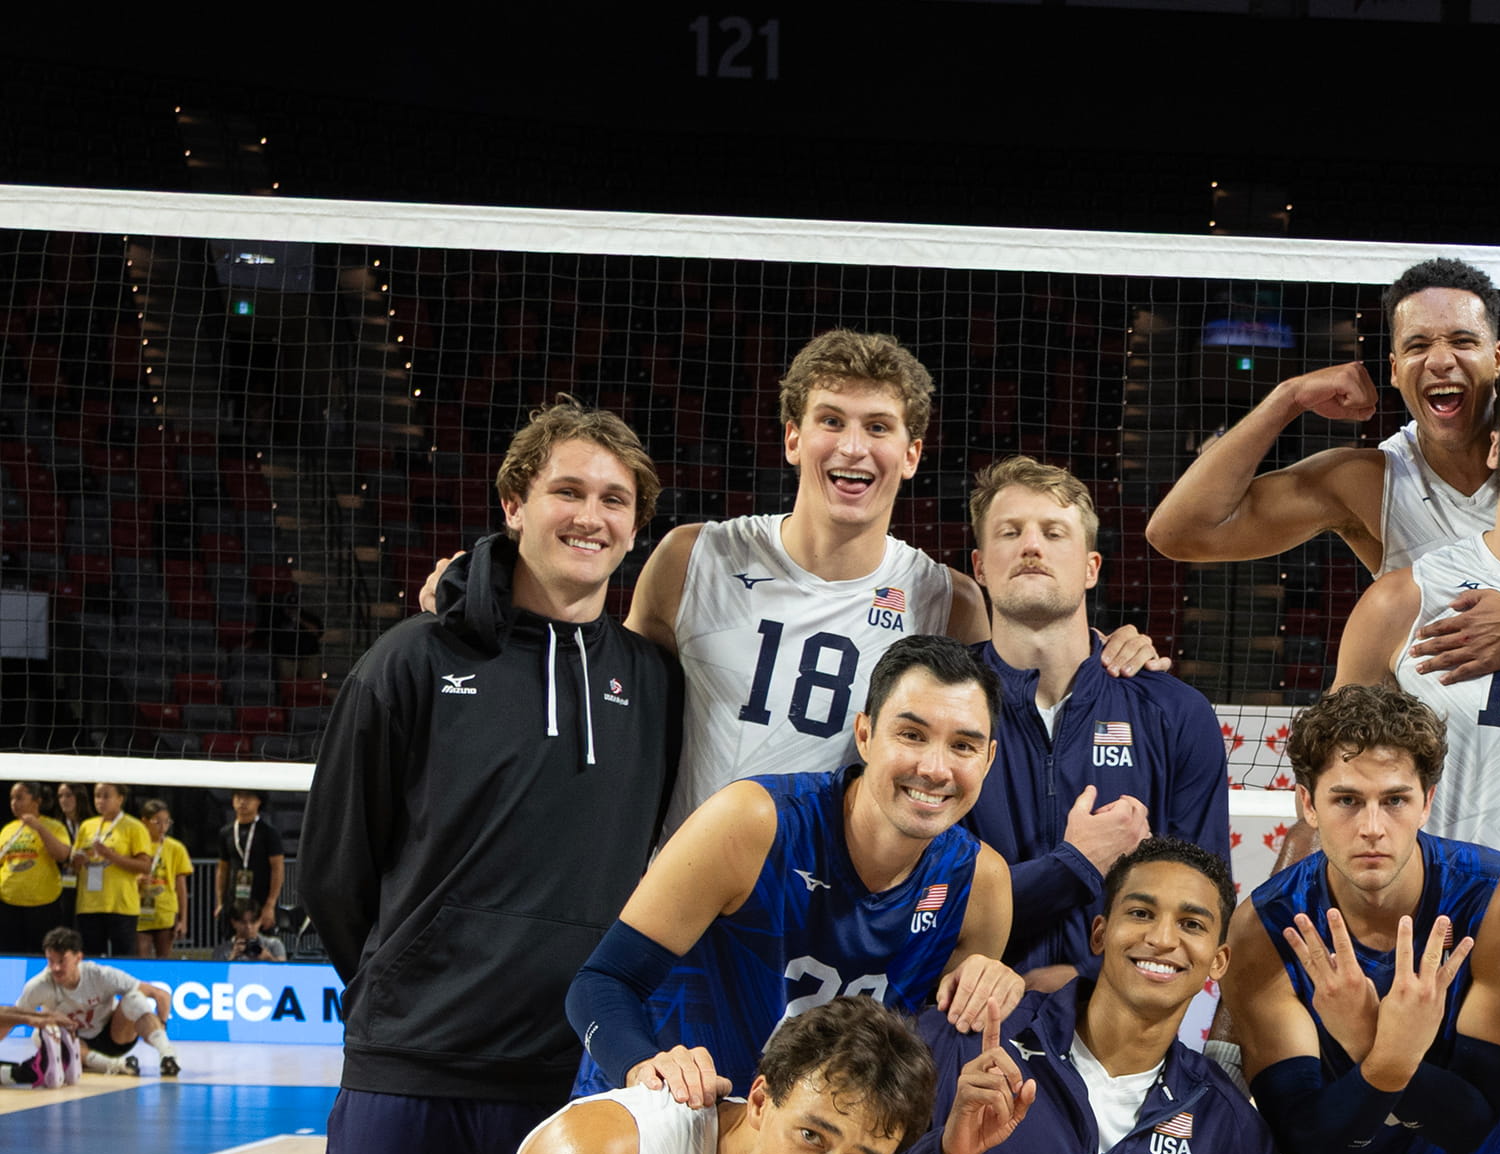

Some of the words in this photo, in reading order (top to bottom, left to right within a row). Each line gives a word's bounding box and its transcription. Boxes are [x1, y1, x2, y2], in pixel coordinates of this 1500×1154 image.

[688, 16, 780, 80] 121
[867, 608, 904, 632] USA
[738, 619, 860, 739] 18
[1092, 746, 1133, 767] USA
